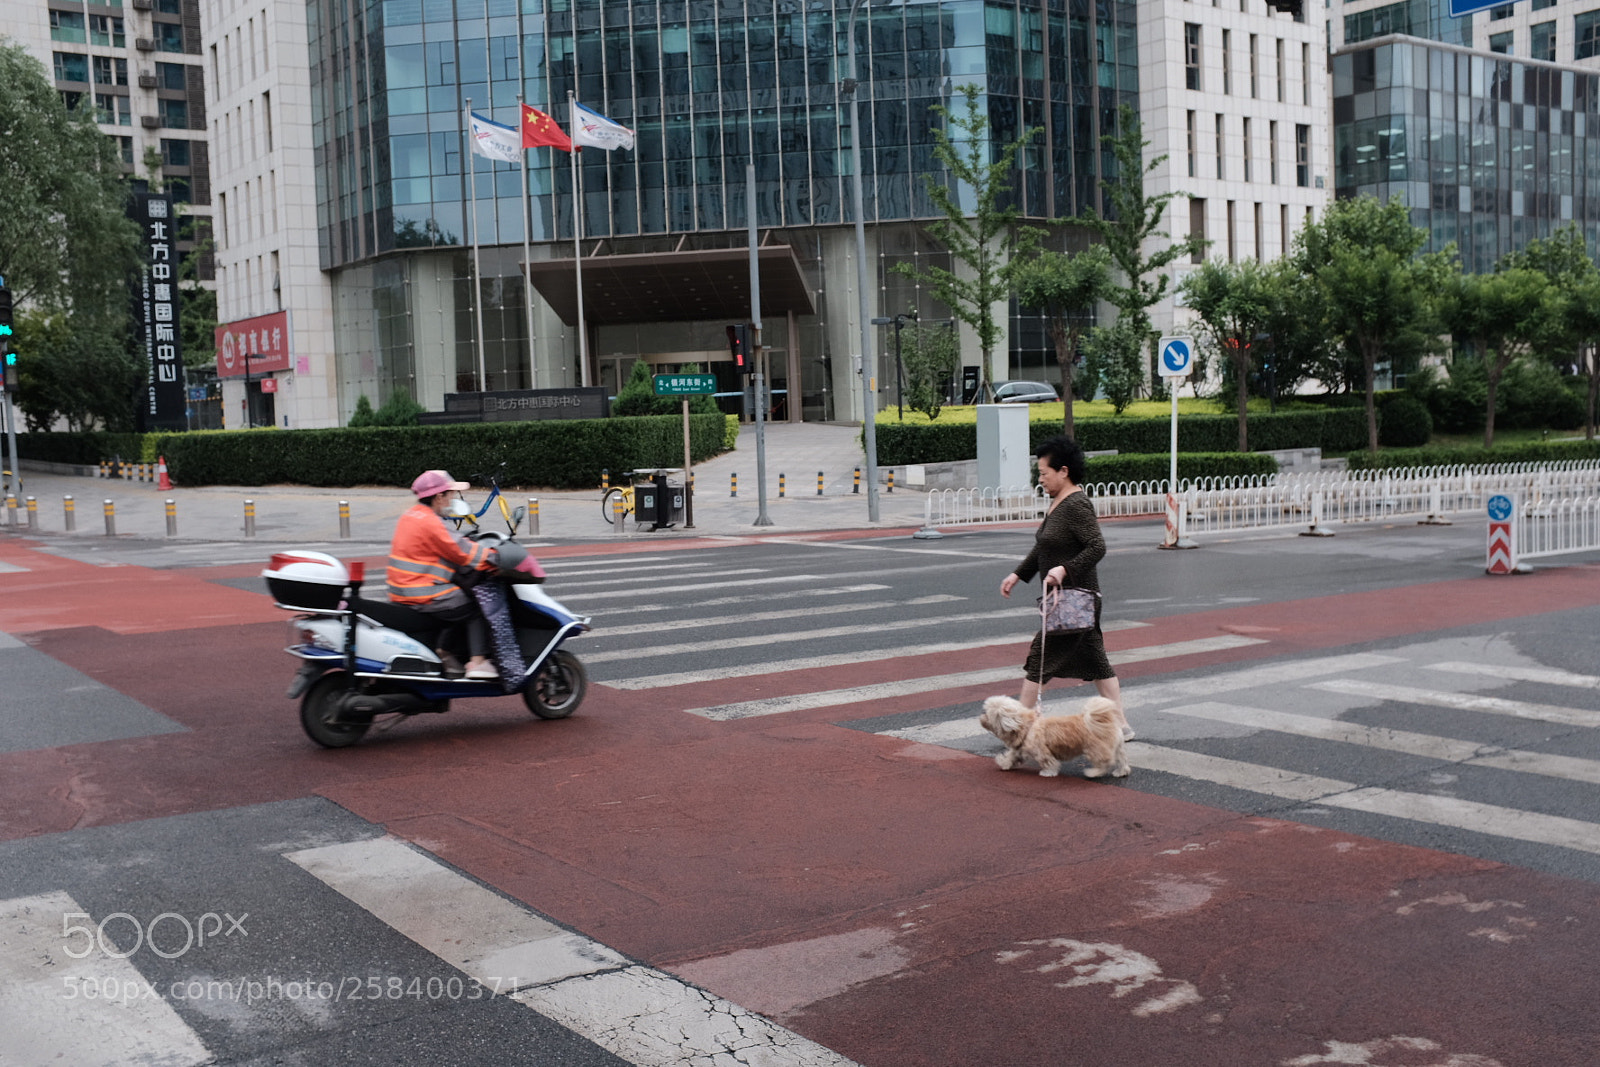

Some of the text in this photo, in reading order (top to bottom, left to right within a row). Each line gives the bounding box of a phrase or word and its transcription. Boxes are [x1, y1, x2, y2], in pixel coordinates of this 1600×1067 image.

[149, 221, 177, 382] 北方中惠国际中心
[148, 386, 157, 415] CENTRE
[497, 395, 581, 411] 北方中惠国际中心
